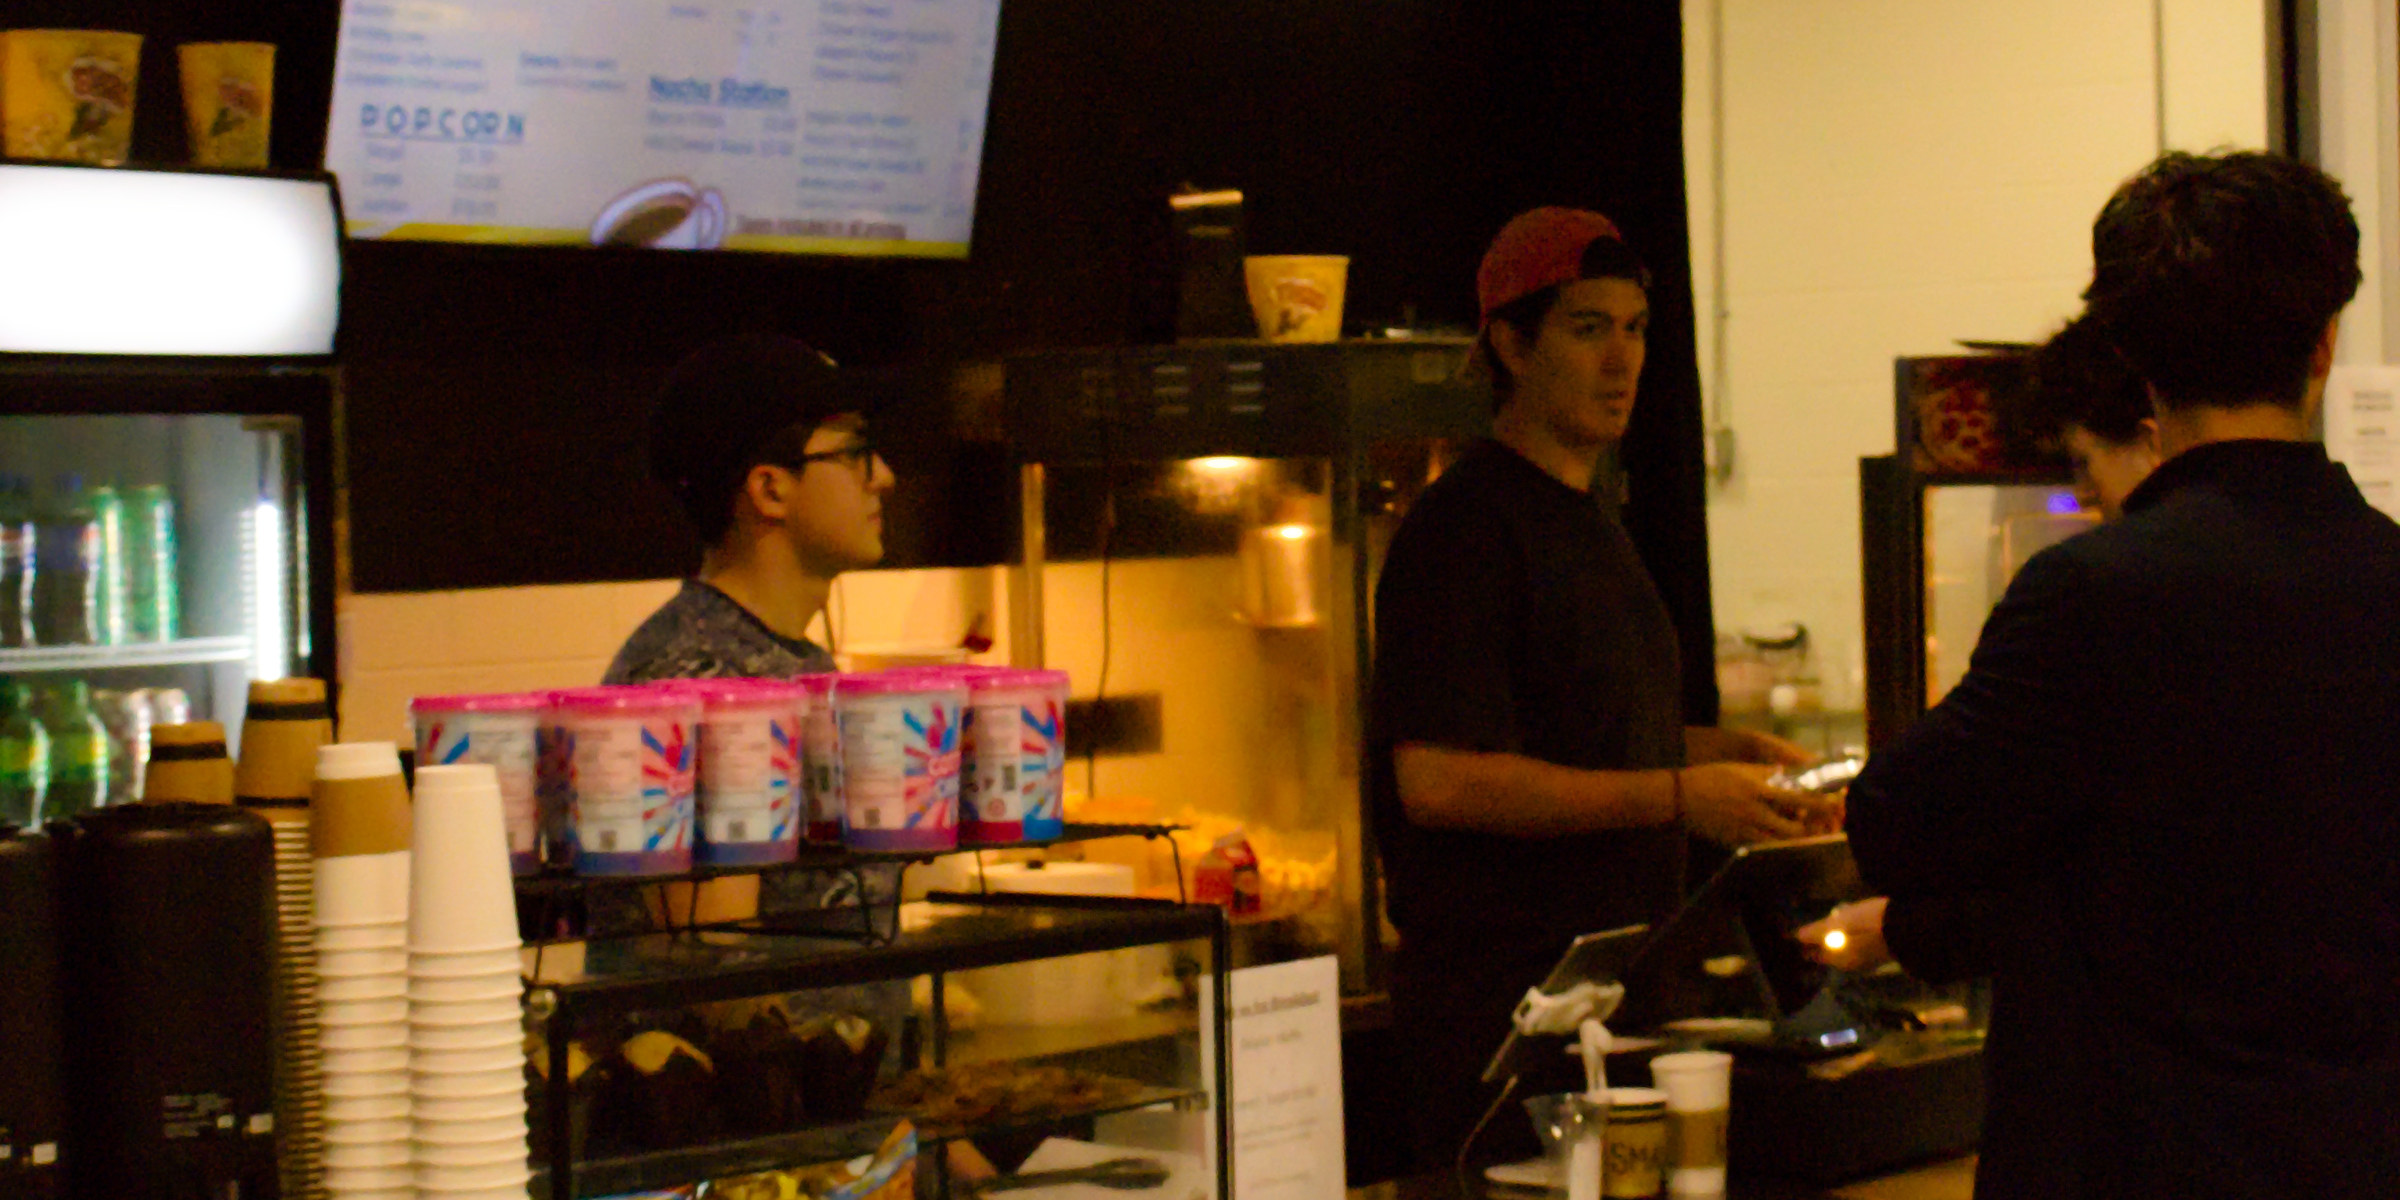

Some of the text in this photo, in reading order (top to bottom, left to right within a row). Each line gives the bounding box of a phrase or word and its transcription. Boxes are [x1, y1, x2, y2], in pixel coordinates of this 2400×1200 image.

[650, 75, 712, 102] Nacho
[719, 78, 791, 105] Station
[360, 103, 526, 138] POPCORN
